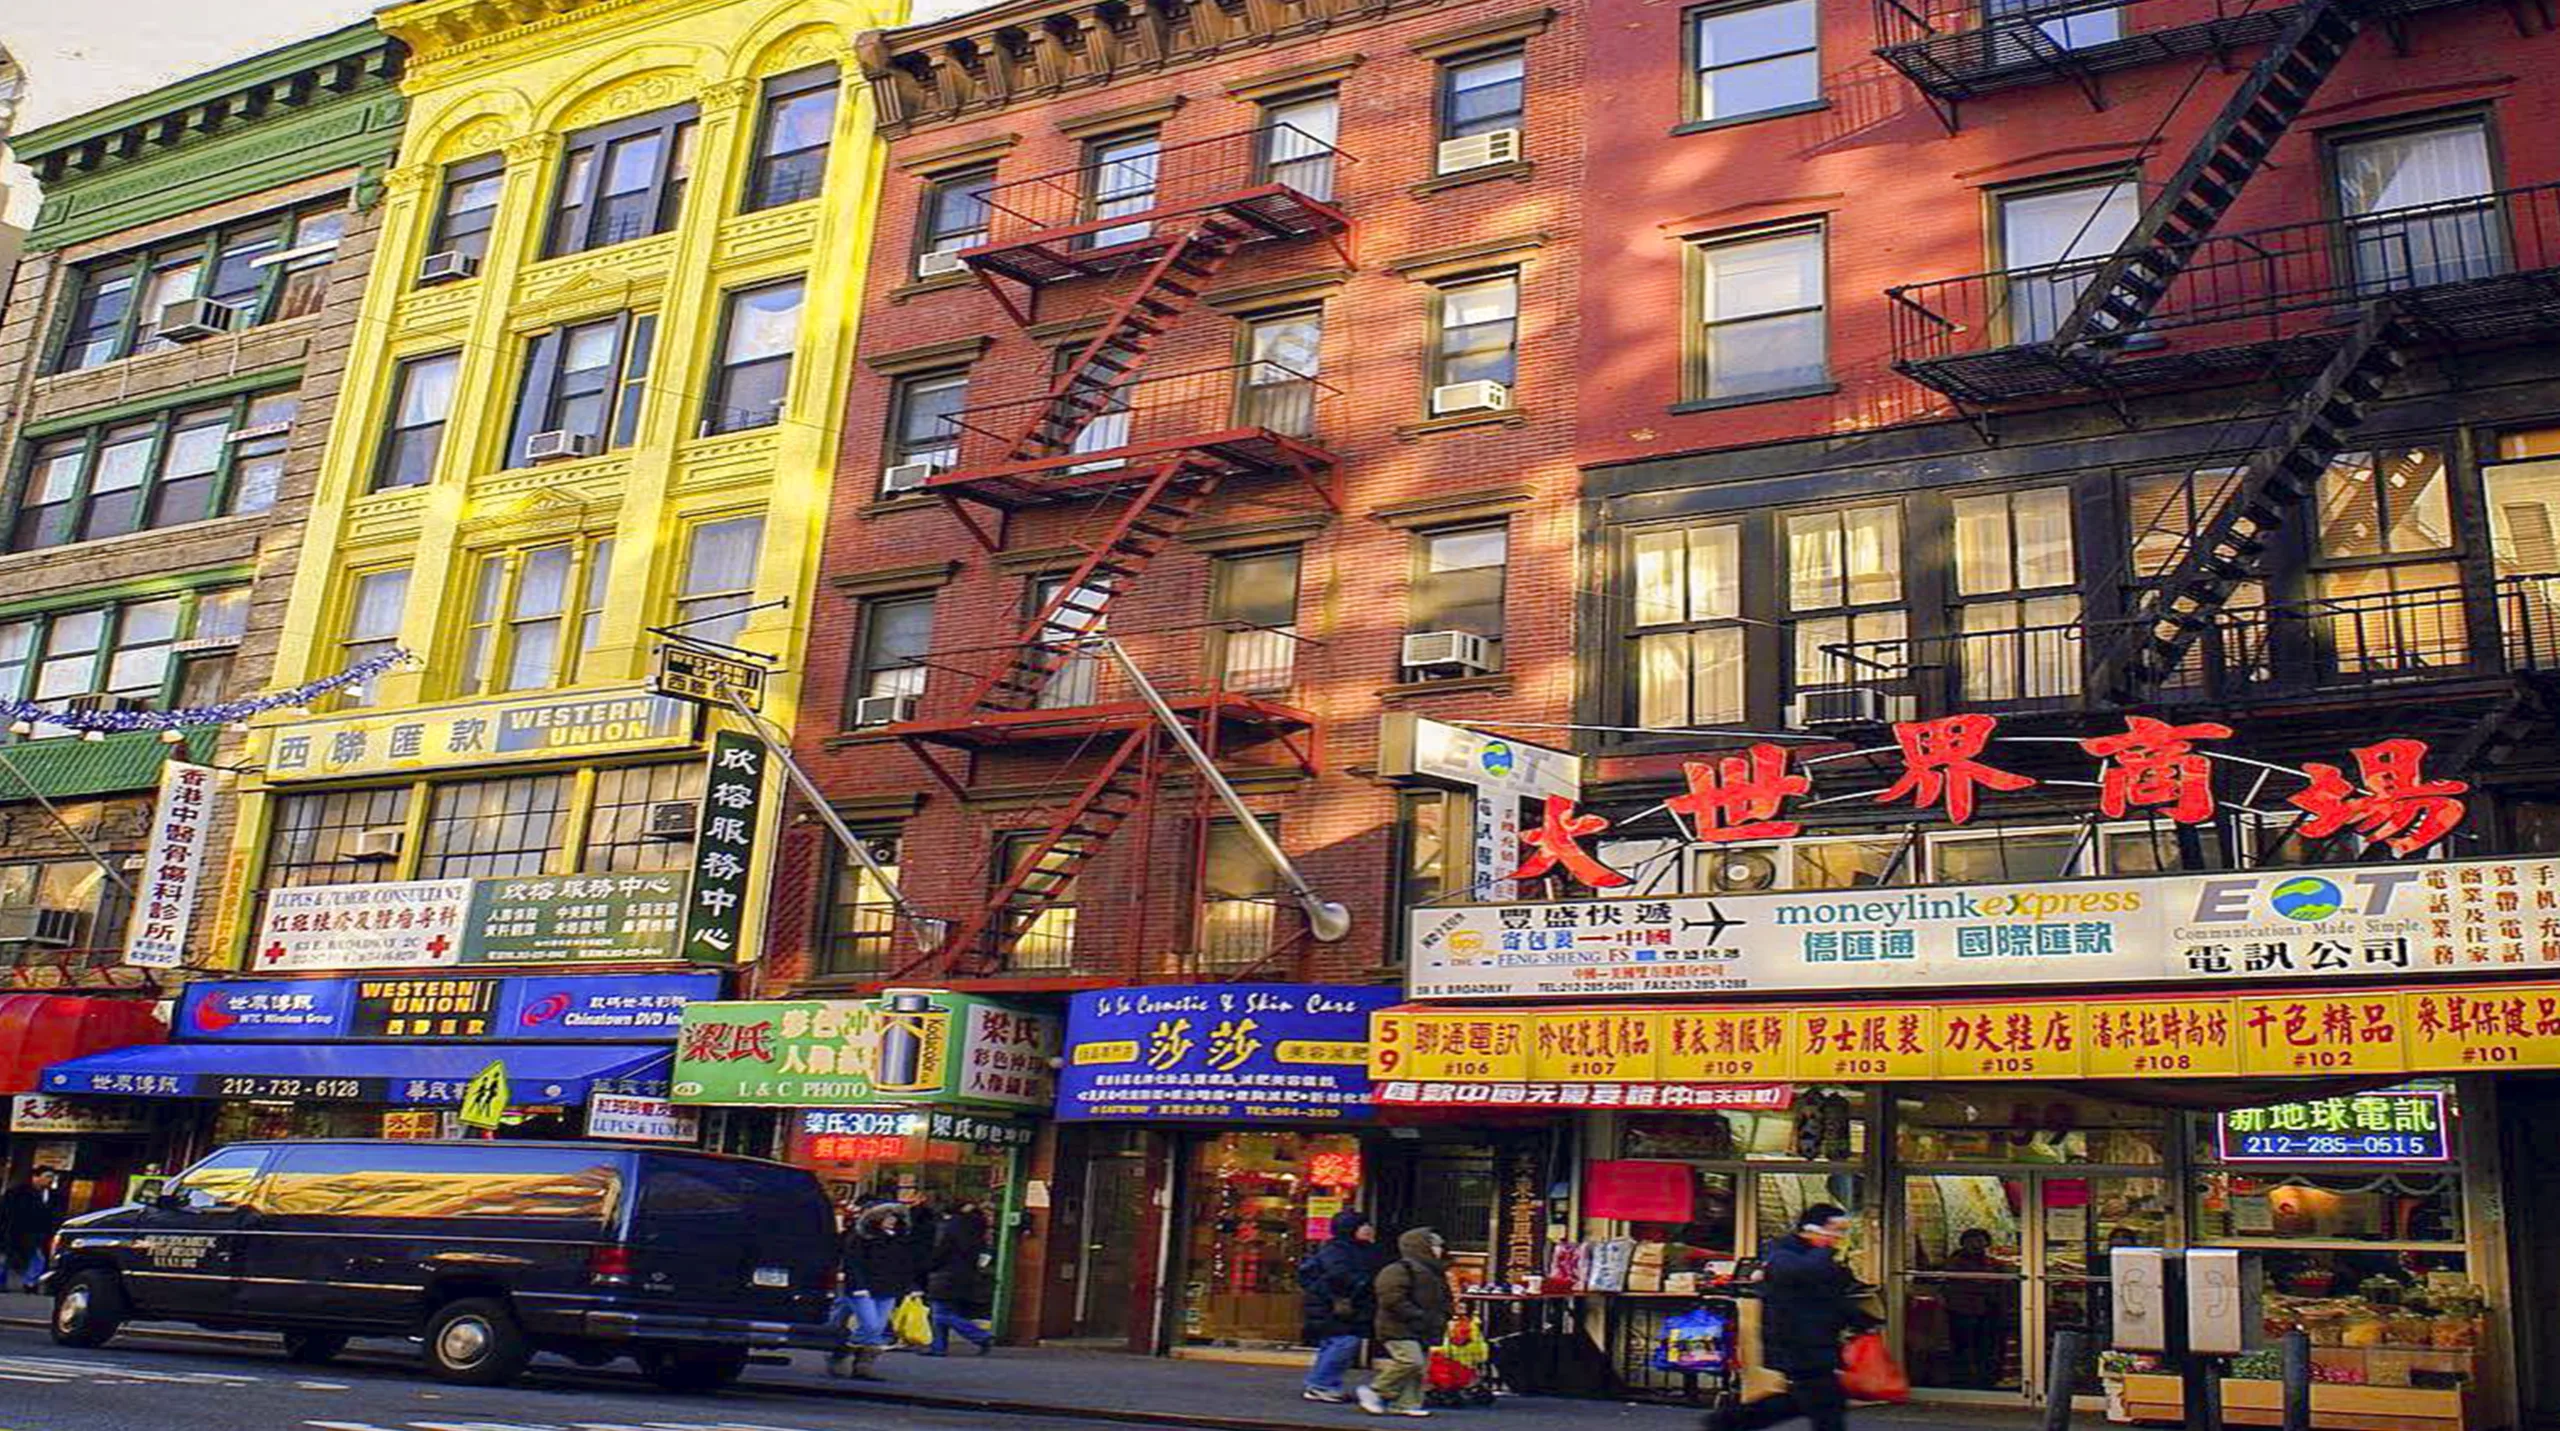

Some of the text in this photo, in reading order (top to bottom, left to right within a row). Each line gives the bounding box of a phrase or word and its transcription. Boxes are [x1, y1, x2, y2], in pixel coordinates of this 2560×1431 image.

[510, 698, 650, 729] WESTERN
[549, 721, 648, 747] UNION
[276, 719, 486, 770] 西聯匯款
[144, 768, 207, 943] 香港中醫骨傷科診所
[1500, 902, 1673, 930] 豐盛快遞
[2174, 924, 2301, 942] Communications
[2312, 920, 2356, 936] Made
[1804, 921, 2113, 963] 僑匯通 國際匯款
[1545, 950, 1602, 964] SHENG
[2184, 937, 2410, 973] 電訊公司
[362, 981, 474, 999] WESTERN
[391, 997, 472, 1013] UNION
[1245, 993, 1294, 1014] Skin
[1305, 993, 1358, 1014] Care
[634, 1012, 663, 1025] DVD
[2416, 995, 2560, 1043] 參茸保健品
[1803, 1013, 1925, 1056] 男士服裝
[1944, 1010, 2073, 1054] 力夫鞋店
[1147, 1018, 1262, 1071] 莎莎
[2462, 1046, 2519, 1062] #101
[1444, 1061, 1490, 1076] #106
[1569, 1061, 1618, 1076] #107
[1703, 1060, 1754, 1075] #109
[1834, 1059, 1887, 1074] #103
[1981, 1058, 2034, 1073] #105
[2133, 1055, 2191, 1071] #108
[2293, 1051, 2354, 1068] #102
[738, 1081, 867, 1098] L & C PHOTO
[2228, 1096, 2438, 1133] 新地球電訊
[593, 1117, 635, 1135] LUPUS
